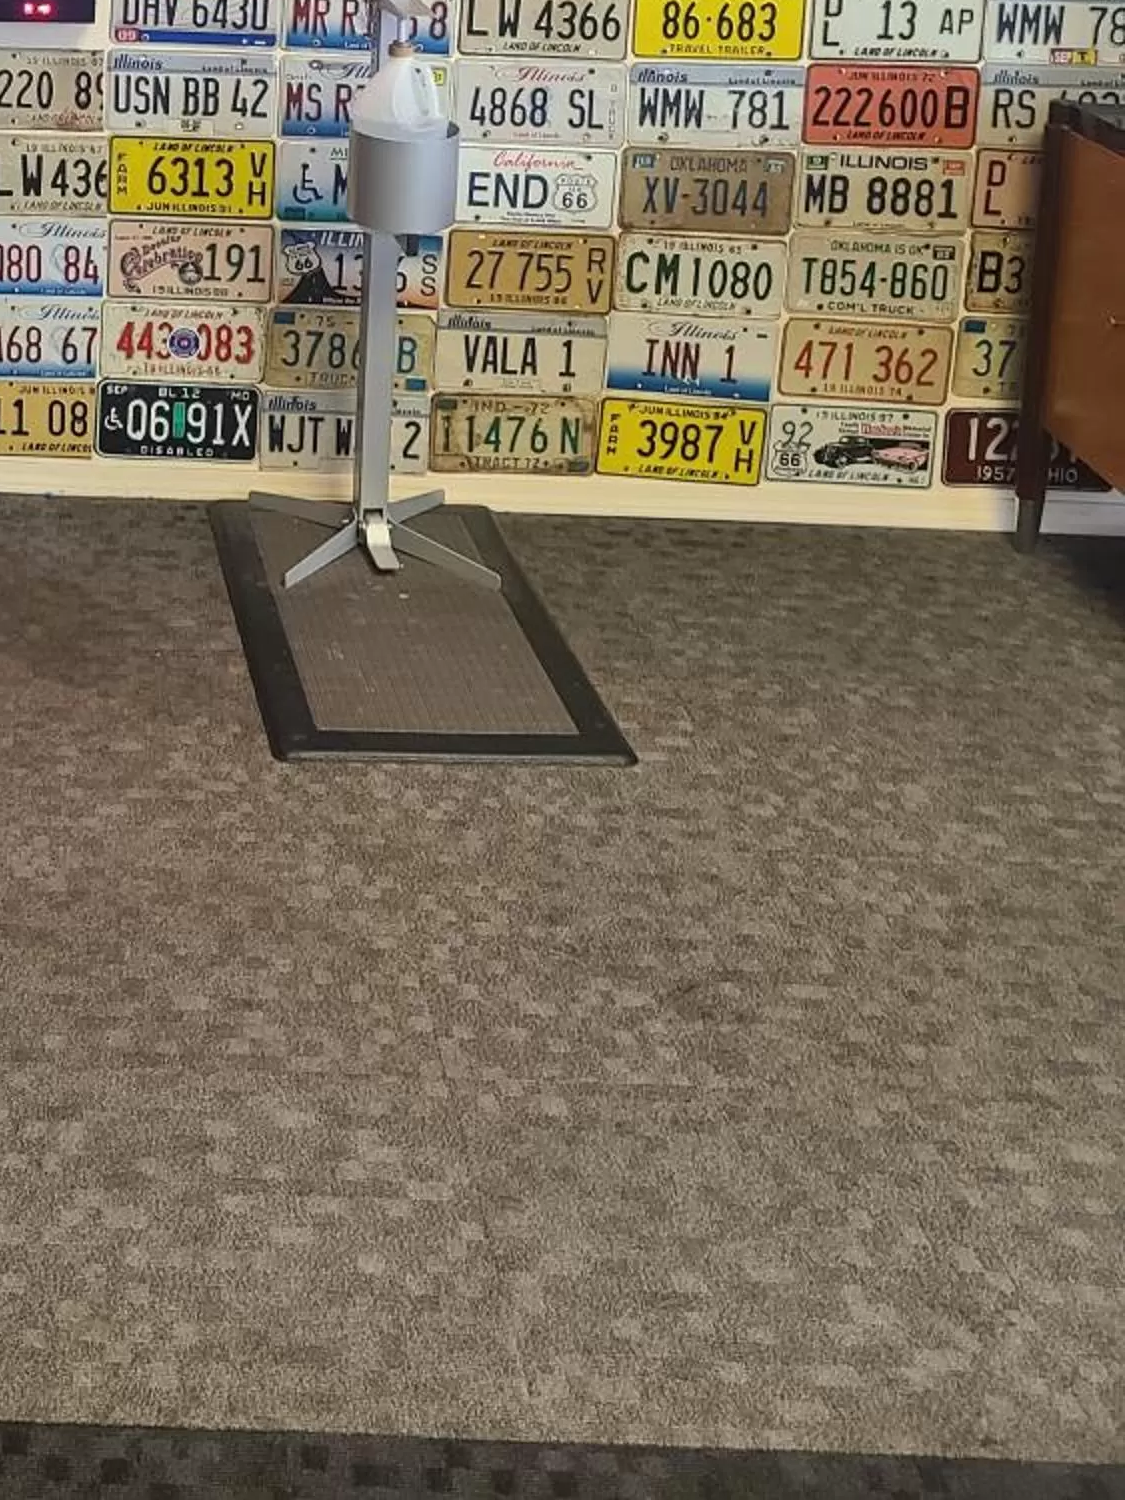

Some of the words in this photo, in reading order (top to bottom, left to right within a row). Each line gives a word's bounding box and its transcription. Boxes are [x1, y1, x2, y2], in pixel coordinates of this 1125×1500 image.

[115, 76, 170, 113] USN
[182, 78, 225, 115] BB
[231, 80, 268, 118] 42
[470, 88, 548, 128] 4868
[568, 89, 604, 129] SL
[639, 90, 704, 128] WMW
[727, 90, 789, 131] 781
[147, 157, 234, 196] 6313
[493, 152, 576, 170] California
[839, 155, 927, 170] ILLINOIS
[469, 172, 548, 209] END
[558, 193, 589, 209] 66
[804, 177, 848, 215] MB
[865, 179, 957, 219] 8881
[205, 244, 265, 282] 191
[466, 251, 512, 289] 27
[519, 254, 573, 292] 755
[794, 346, 853, 380] 471
[873, 348, 938, 388] 362
[141, 446, 213, 456] DISABLED
[637, 420, 723, 464] 3987
